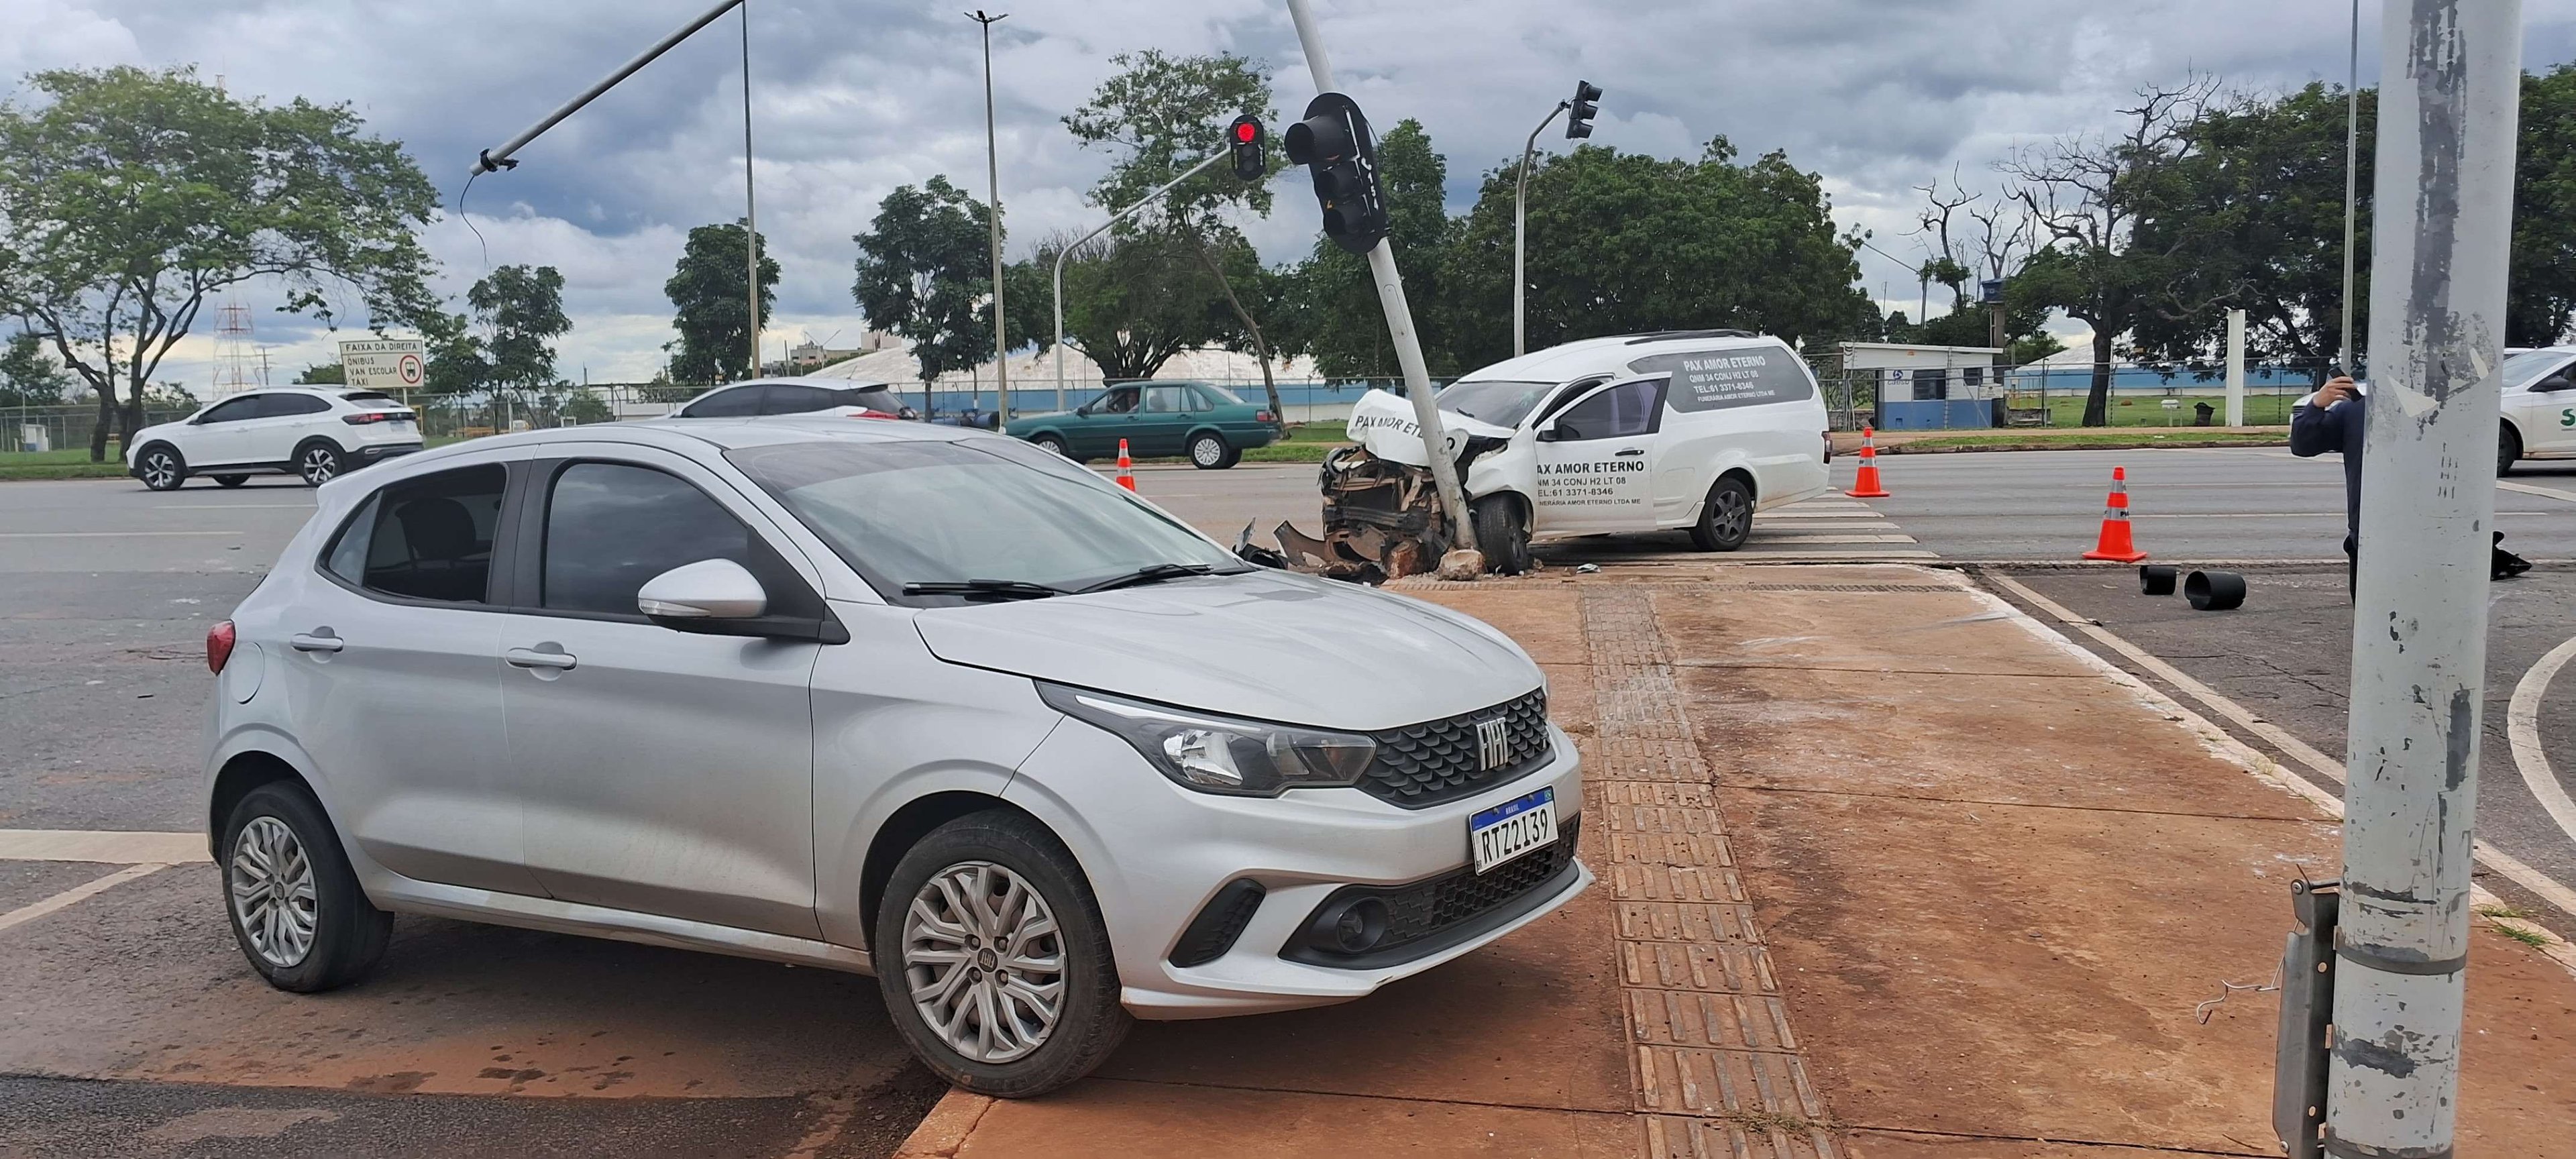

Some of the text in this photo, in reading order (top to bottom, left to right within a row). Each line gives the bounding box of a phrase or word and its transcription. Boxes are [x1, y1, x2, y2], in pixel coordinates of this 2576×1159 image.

[345, 342, 417, 351] FAIXA DA DIREITA
[1683, 355, 1766, 372] PAX AMOR ETERNO
[350, 366, 398, 376] VAN ESCOLAR
[1689, 370, 1759, 383] QNM 34 CONJ H2 LT 08
[1719, 382, 1754, 391] 3371-8346
[1737, 391, 1756, 399] ETERNO
[1355, 415, 1377, 431] PAX
[1537, 461, 1644, 475] AX AMOR ETERNO
[1538, 476, 1626, 487] NM 34 CONJ H2 LT 08
[1538, 488, 1613, 497] EL:61 3371-8346
[1477, 717, 1509, 771] FIAT
[1505, 804, 1519, 815] BRASIL
[979, 950, 996, 969] FIAT
